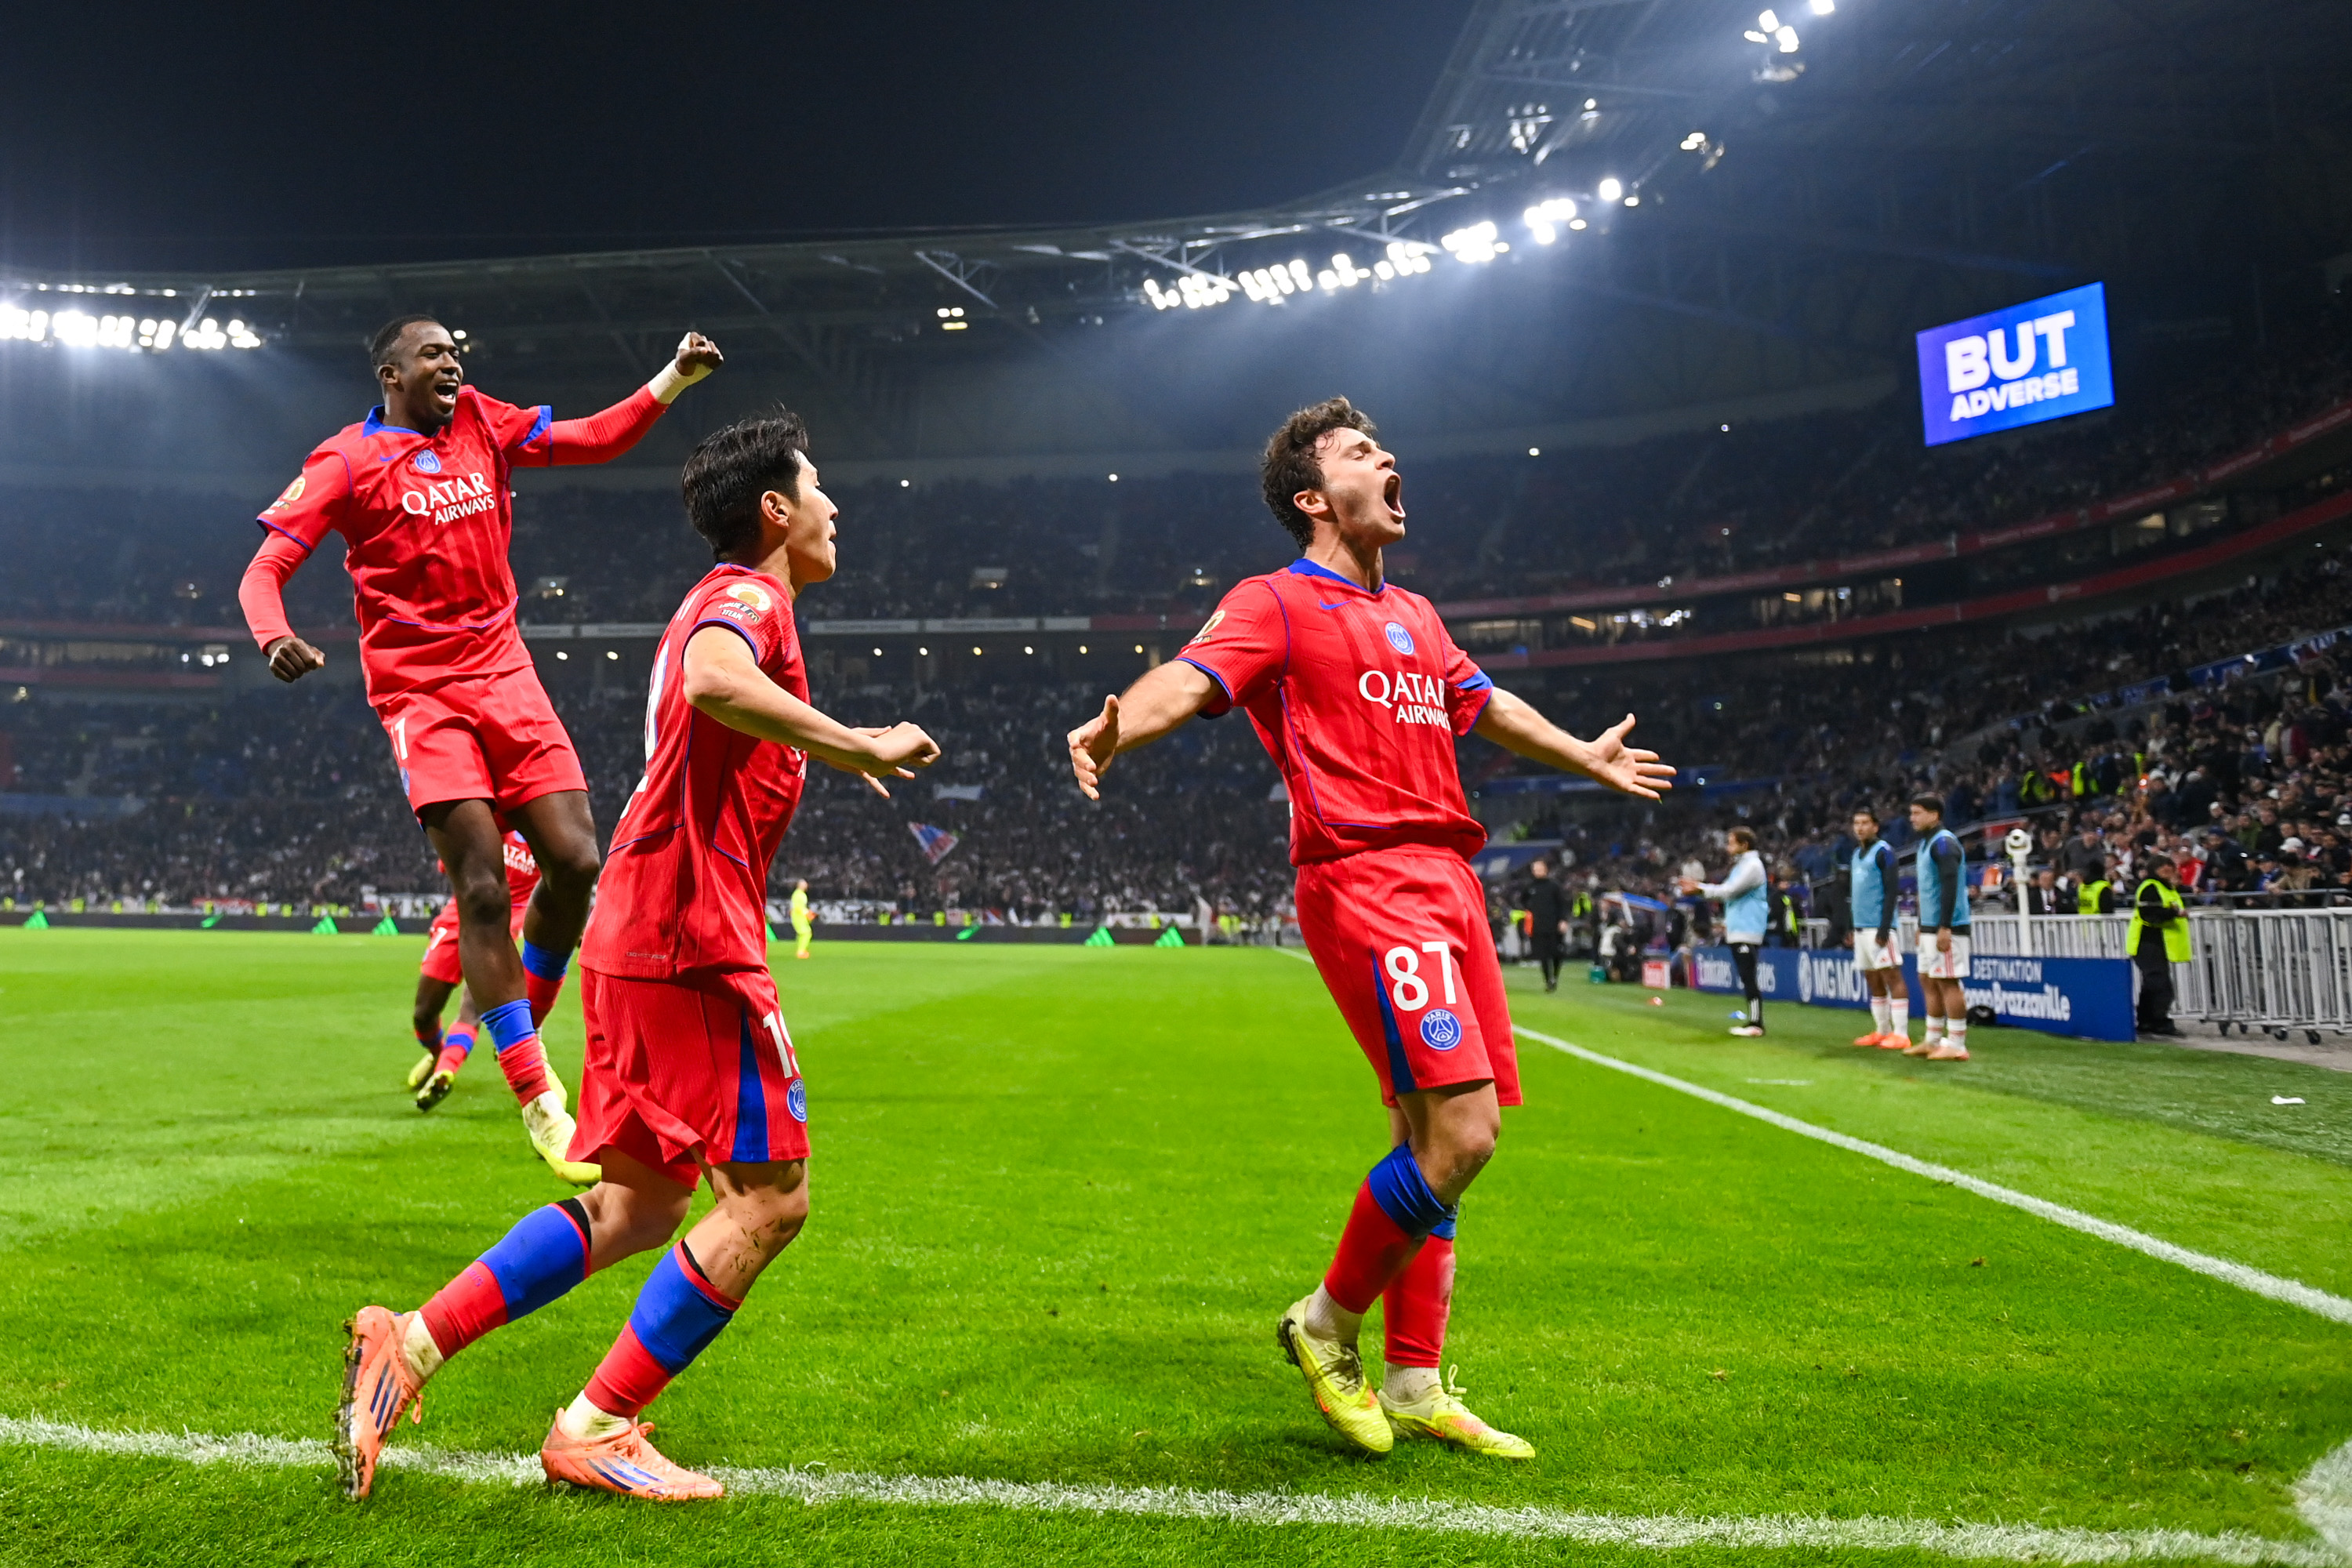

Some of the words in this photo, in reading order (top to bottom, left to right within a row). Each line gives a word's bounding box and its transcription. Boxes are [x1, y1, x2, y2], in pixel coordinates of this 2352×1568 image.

[1945, 310, 2076, 394] BUT
[1950, 367, 2079, 422] ADVERSE
[401, 472, 492, 517] QATAR
[434, 494, 495, 525] AIRWAYS
[1385, 941, 1457, 1011] 87
[1973, 958, 2042, 983] DESTINATION
[1425, 1011, 1451, 1024] PARIS
